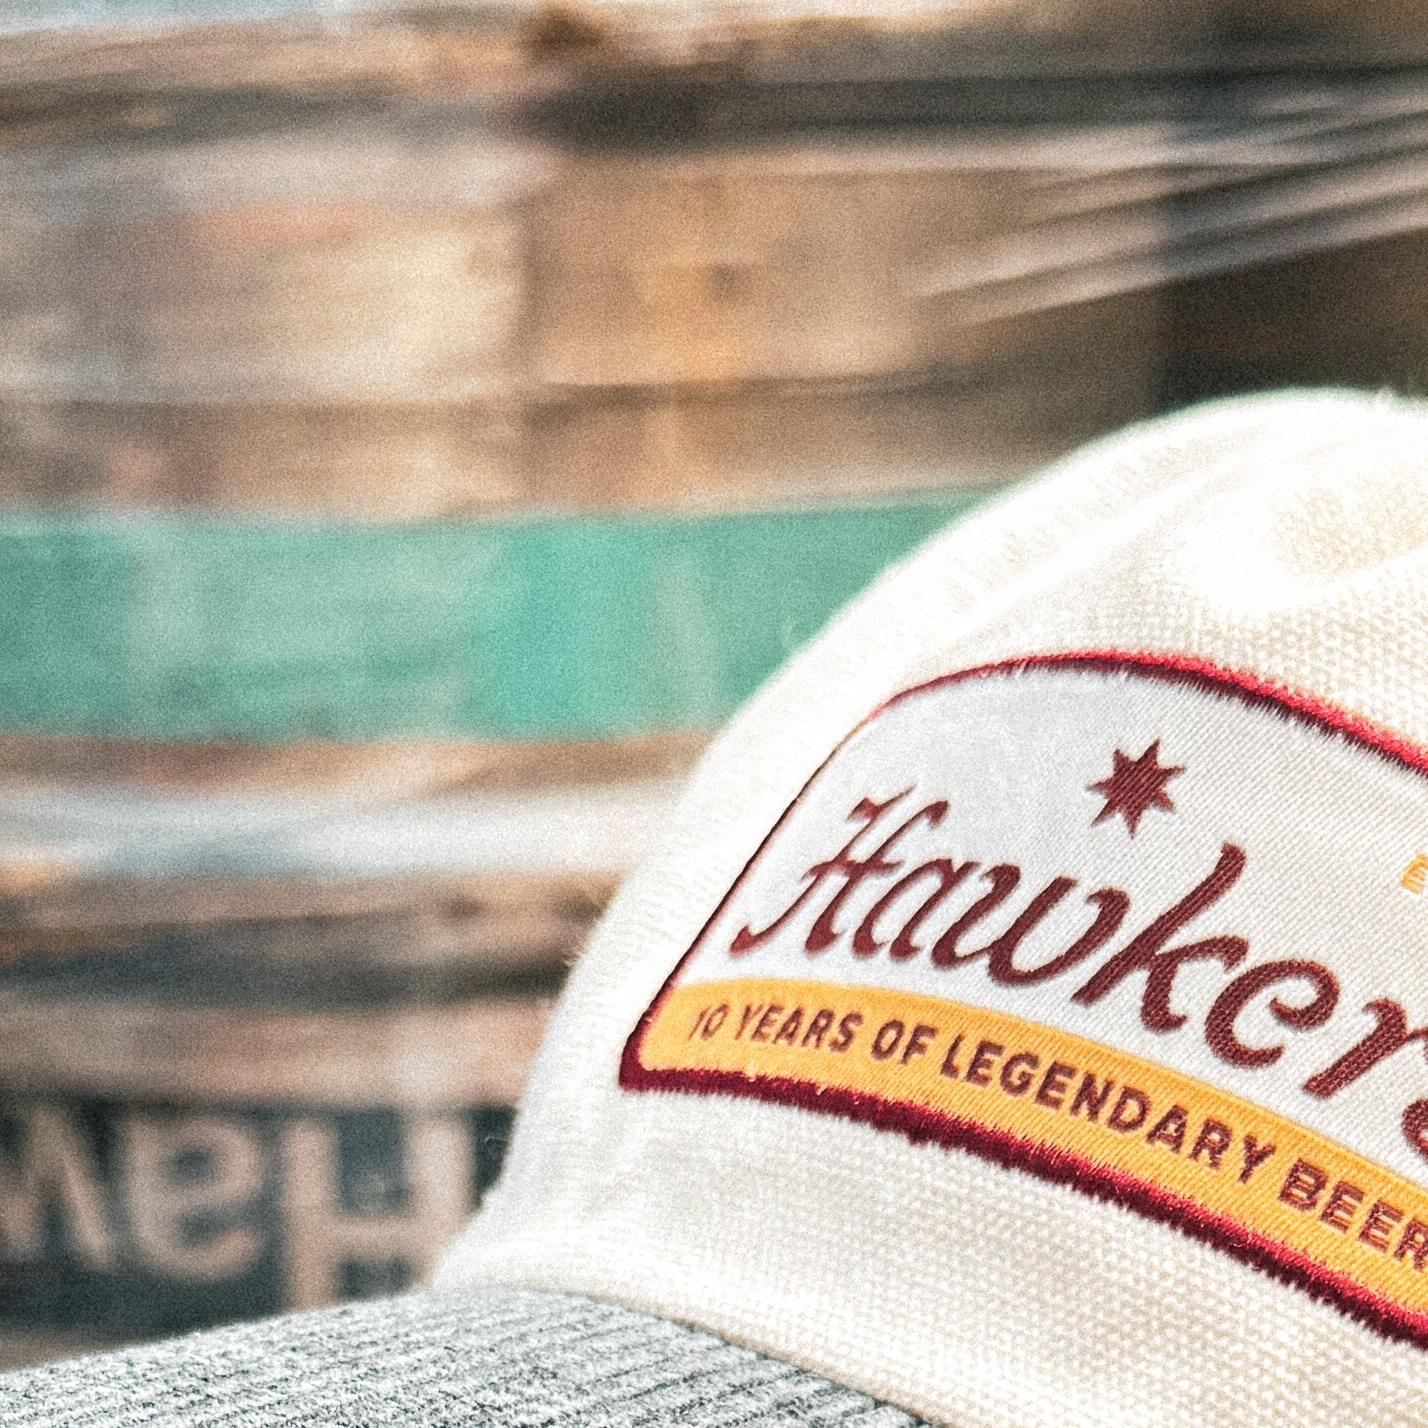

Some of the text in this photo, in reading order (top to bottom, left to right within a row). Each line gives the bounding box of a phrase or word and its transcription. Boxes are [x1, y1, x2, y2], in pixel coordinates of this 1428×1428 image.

[687, 1003, 731, 1042] 10
[734, 1003, 863, 1052] YEARS
[871, 1019, 939, 1066] OF
[938, 1033, 1276, 1184] LEGENDARY
